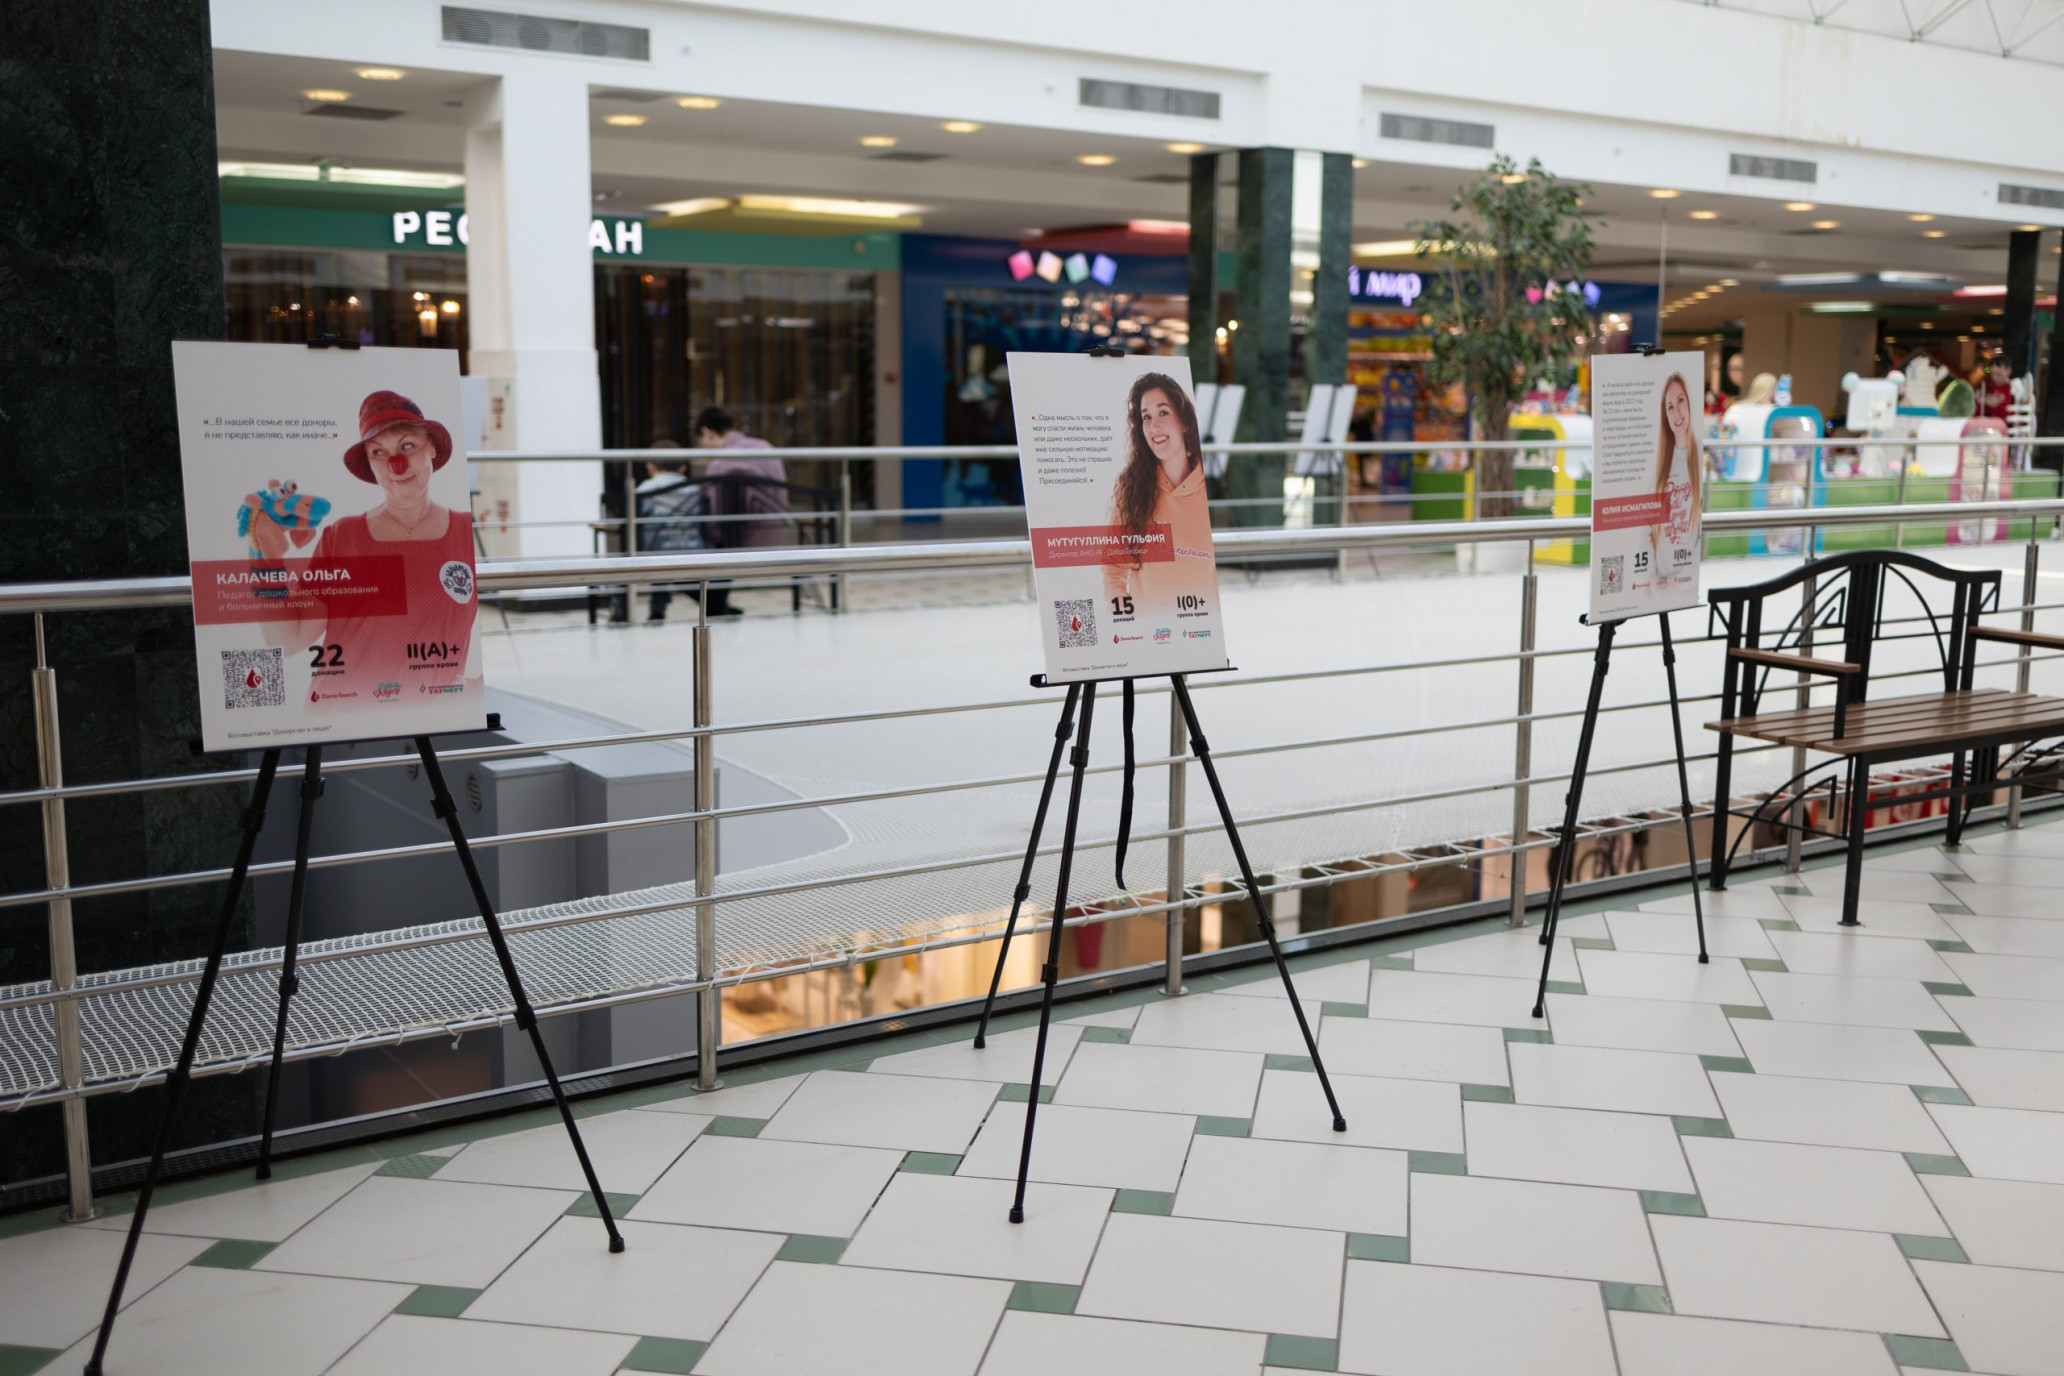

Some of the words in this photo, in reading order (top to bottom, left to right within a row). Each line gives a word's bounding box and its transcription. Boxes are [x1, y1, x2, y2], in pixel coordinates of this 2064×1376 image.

[224, 417, 255, 426] нашей
[256, 418, 283, 426] семье
[301, 419, 338, 427] доноры,
[224, 431, 285, 440] представляю,
[286, 431, 301, 439] как
[1047, 537, 1120, 547] МУТУГУЛЛИНА
[1121, 533, 1166, 544] ГУЛЬФИЯ
[1634, 552, 1648, 567] 15
[216, 570, 299, 585] КАЛАЧЕВА
[302, 568, 351, 582] ОЛЬГА
[217, 590, 255, 600] Педагог
[257, 587, 319, 599] дошкольного
[321, 585, 379, 596] образования
[226, 600, 285, 611] больничный
[286, 600, 314, 610] клоун
[1111, 596, 1135, 616] 15
[308, 644, 345, 667] 22
